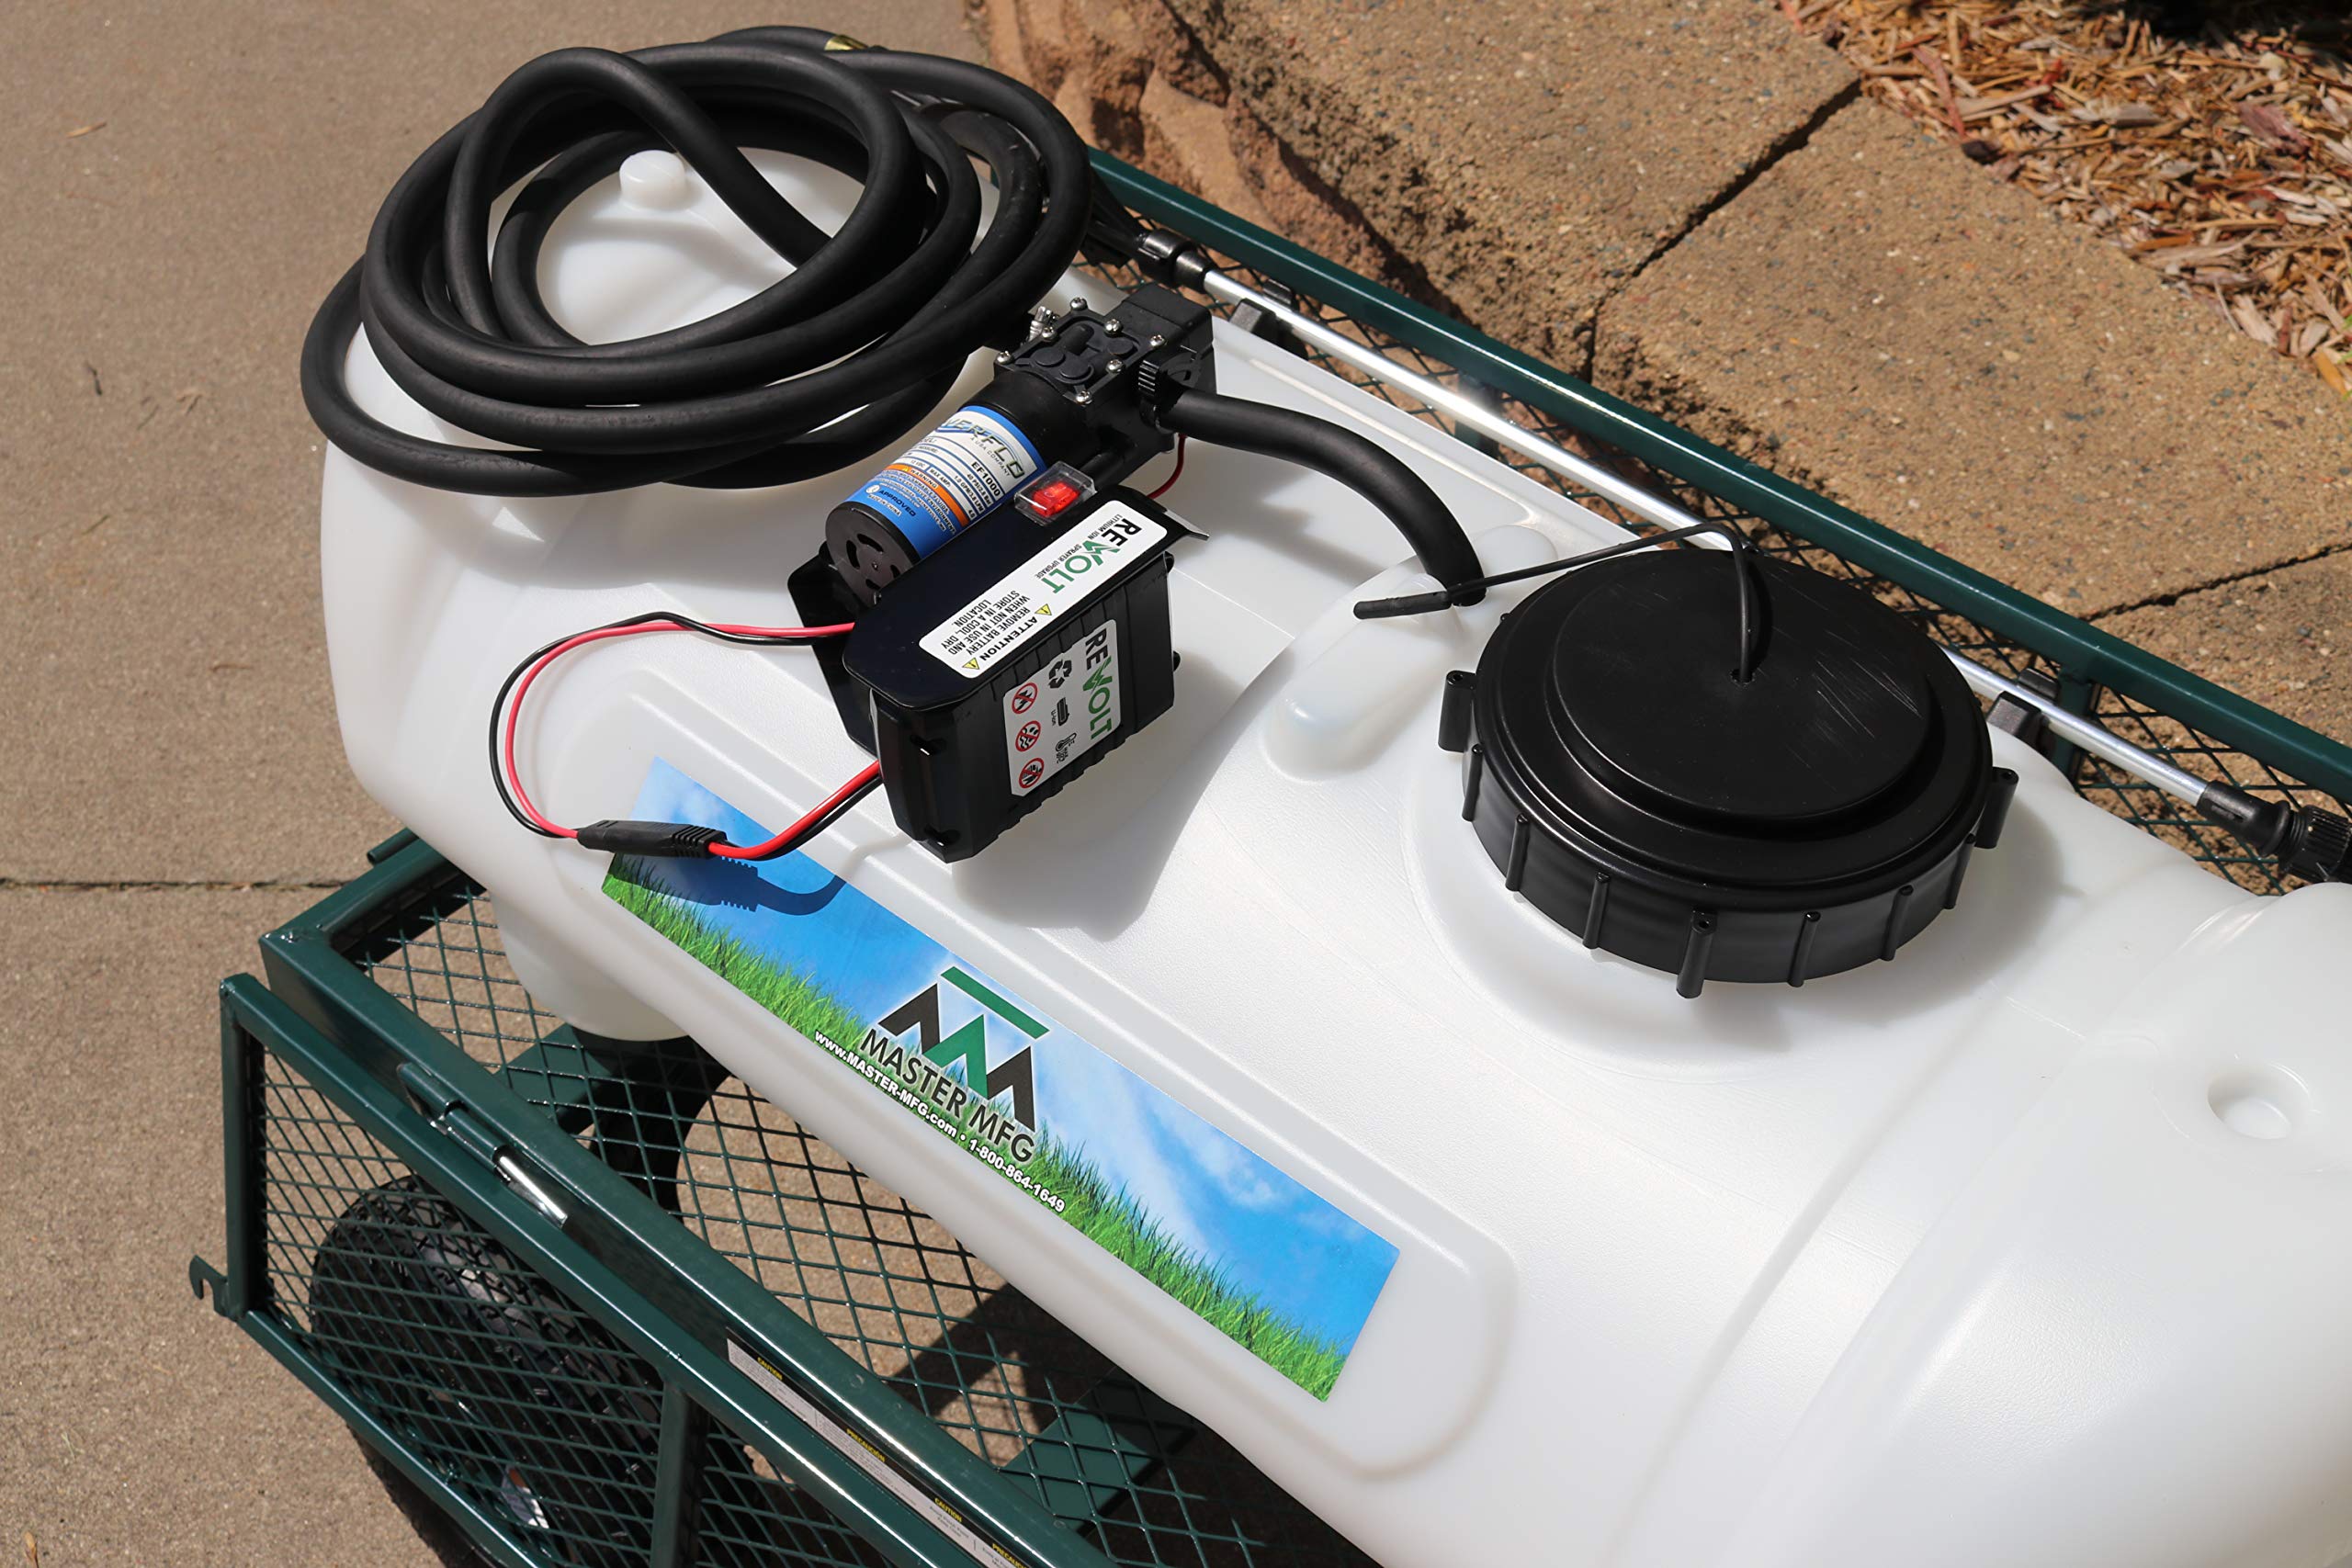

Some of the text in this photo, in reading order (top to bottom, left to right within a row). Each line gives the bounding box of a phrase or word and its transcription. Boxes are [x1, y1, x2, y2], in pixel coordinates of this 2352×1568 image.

[944, 418, 1025, 479] VERFLO
[975, 440, 987, 451] USA
[987, 449, 1011, 477] COMPANY
[910, 468, 937, 489] WARNING
[930, 468, 941, 478] MAX
[971, 461, 1001, 497] EF1000
[878, 490, 917, 517] APPROVED
[886, 502, 902, 517] CHINA
[974, 501, 985, 513] LPM
[1035, 513, 1123, 580] LITHIUM ION SPRAYER UPGRADE
[1041, 518, 1142, 594] REVOLT
[952, 599, 992, 628] LOCATION.
[984, 607, 997, 616] IN
[993, 590, 1020, 610] STORE
[948, 595, 1031, 655] WHEN NOT IN USE AND
[956, 618, 980, 636] COOL,
[966, 607, 1031, 656] REMOVE BATTERY
[979, 616, 1038, 661] ATTENTION
[941, 635, 959, 649] DRY
[1082, 628, 1113, 739] REVOLT
[860, 1028, 1035, 1163] MASTER MFG
[814, 1030, 1066, 1213] www.MASTER-MFG.com 1-800-864-1649
[757, 1357, 783, 1381] CAUTION
[934, 1497, 963, 1523] CAUTION
